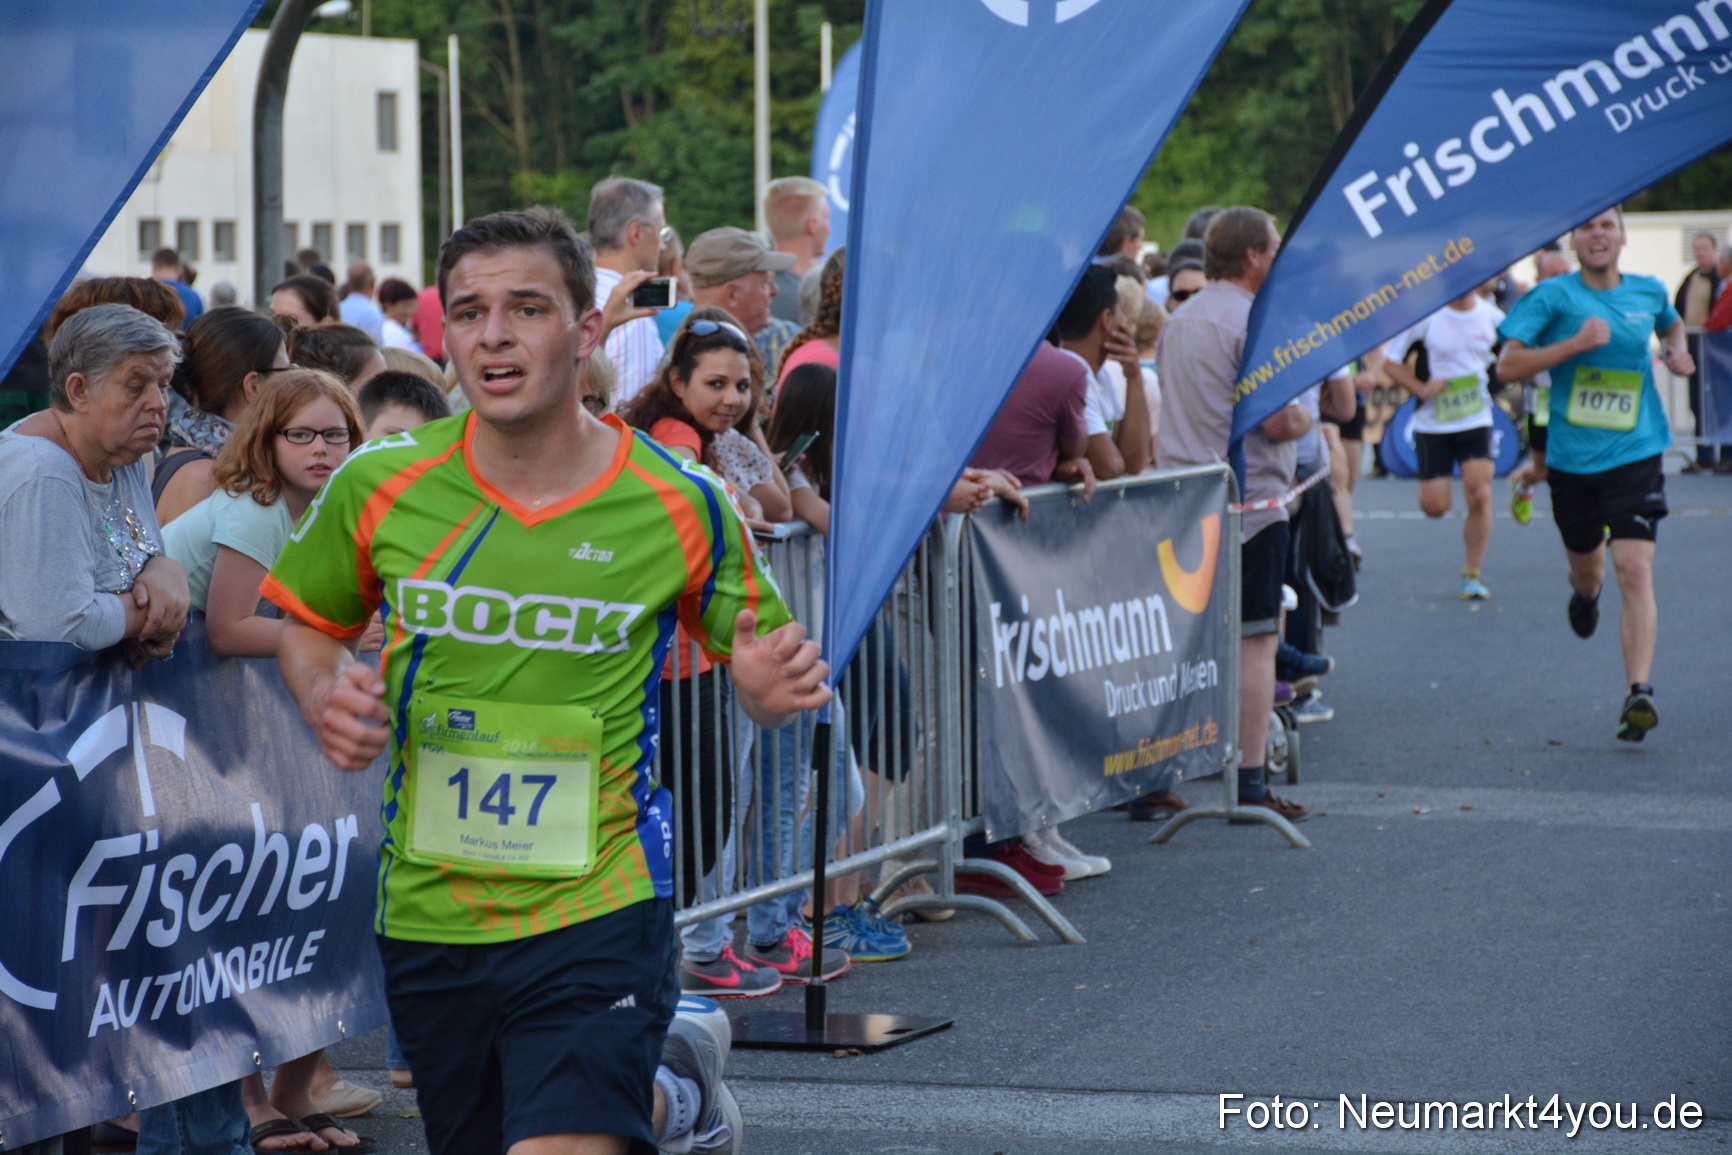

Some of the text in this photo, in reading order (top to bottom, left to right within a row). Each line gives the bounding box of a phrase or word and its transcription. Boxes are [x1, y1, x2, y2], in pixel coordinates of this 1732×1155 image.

[1604, 65, 1706, 133] Druck
[1578, 389, 1632, 414] 1076
[397, 577, 647, 654] BOCK
[990, 588, 1173, 688] Frischmann
[1104, 671, 1148, 718] Druck
[1147, 662, 1177, 707] und
[447, 768, 557, 826] 147
[460, 834, 534, 851] Markus Meier
[62, 803, 359, 962] Fischer
[88, 929, 326, 1038] AUTOMOBILE
